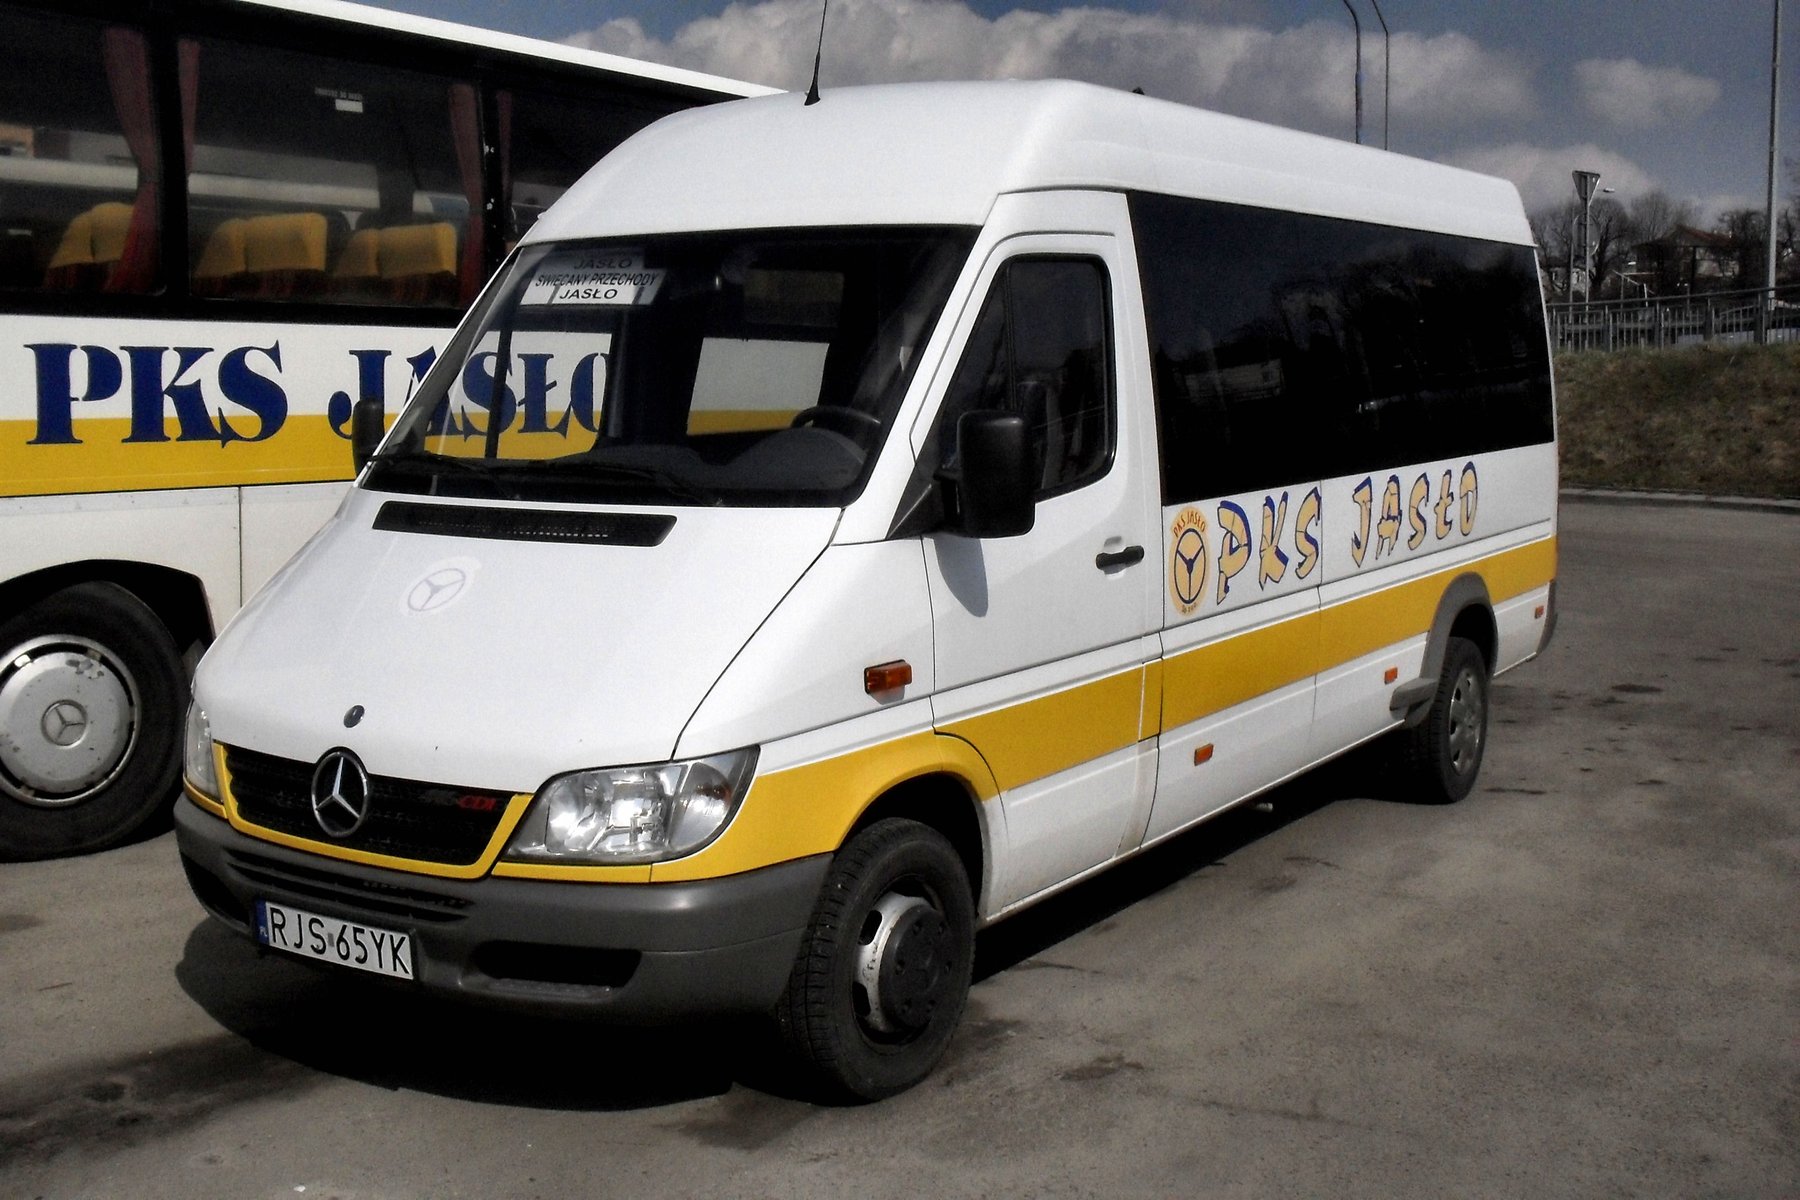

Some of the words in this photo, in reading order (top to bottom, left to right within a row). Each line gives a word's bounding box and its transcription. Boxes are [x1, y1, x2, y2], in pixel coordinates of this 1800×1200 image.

[559, 288, 618, 299] JASŁO
[590, 272, 659, 286] PRZECHODY
[24, 340, 290, 449] PKS
[1217, 486, 1323, 605] PKS
[269, 907, 327, 955] RJS
[336, 924, 410, 974] 65YK
